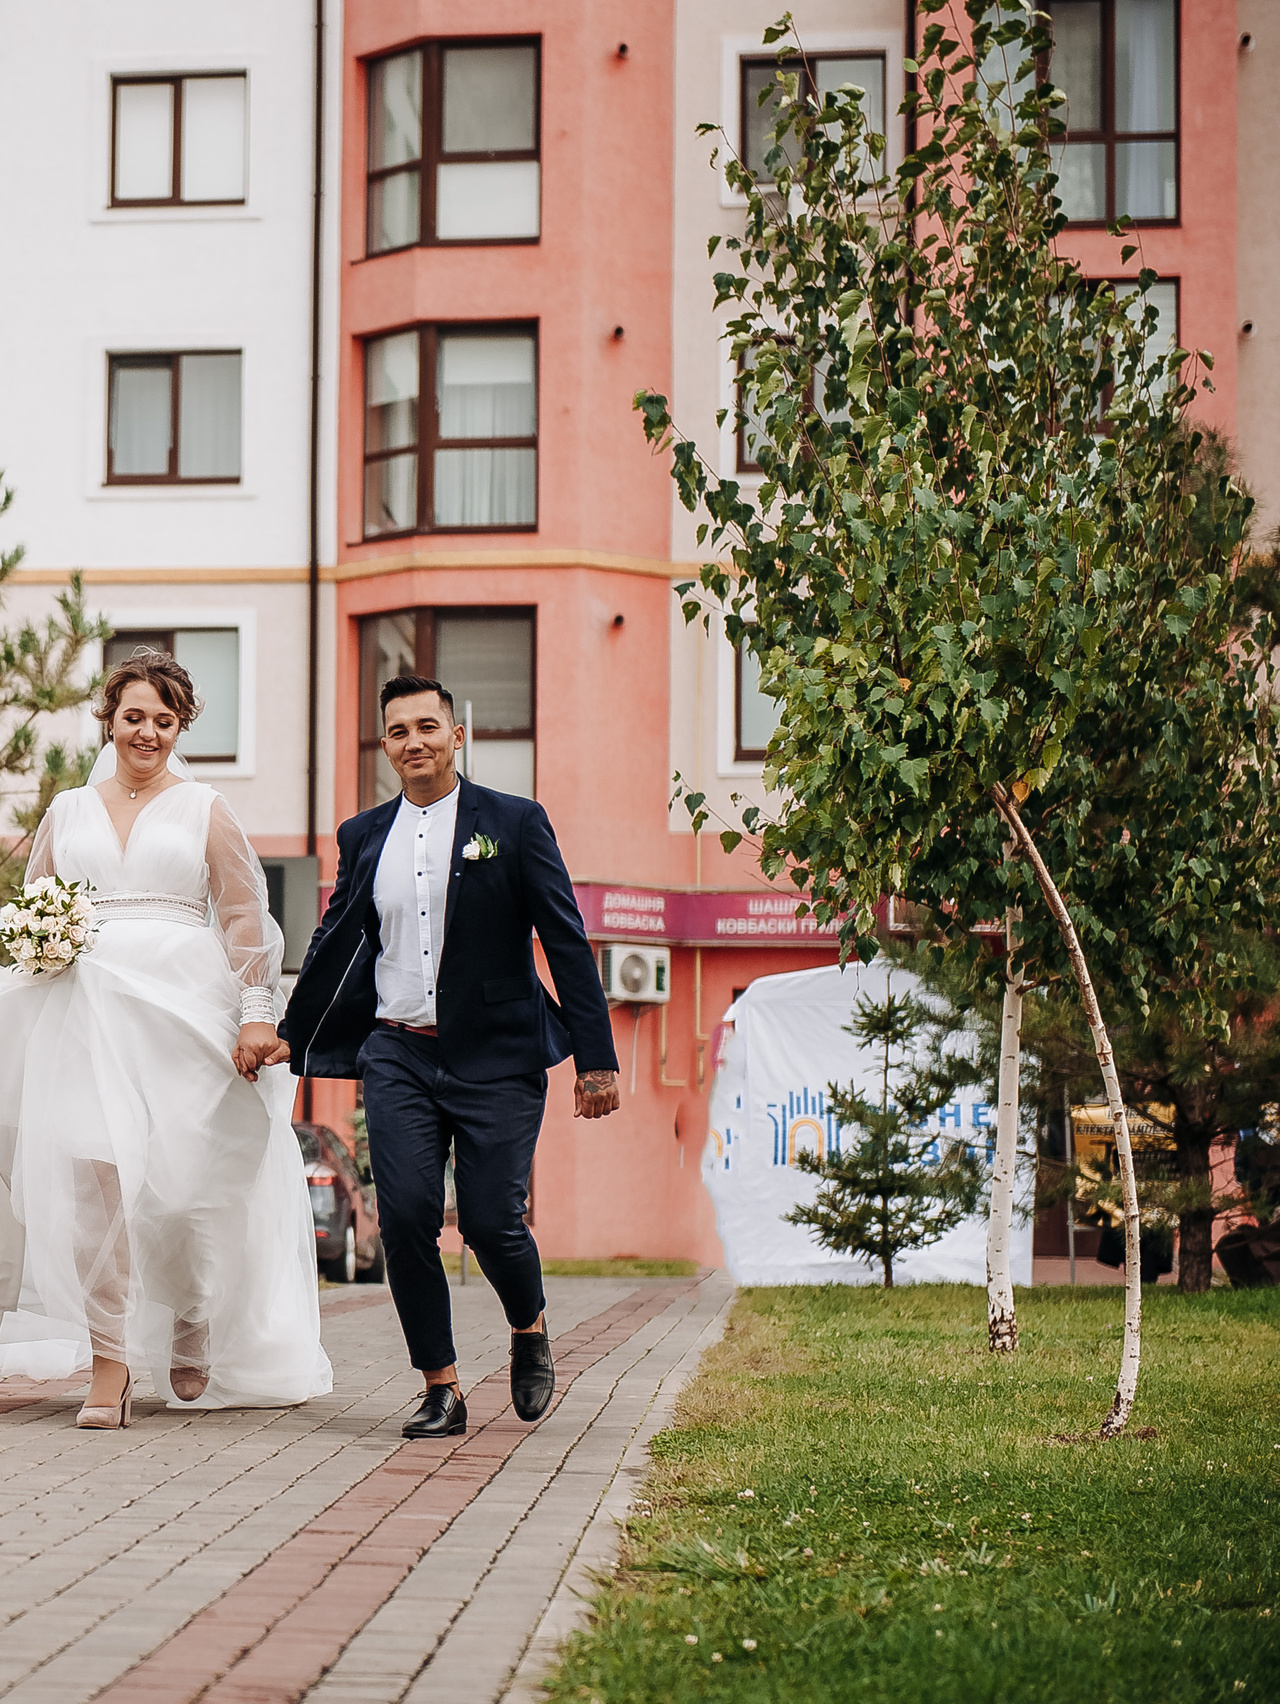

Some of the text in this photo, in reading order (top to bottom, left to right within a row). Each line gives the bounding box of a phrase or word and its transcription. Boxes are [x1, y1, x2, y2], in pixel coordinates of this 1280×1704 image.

[604, 892, 665, 913] ДОМАШНЯ
[603, 912, 666, 932] КОВБАСКА
[716, 918, 797, 934] КОВБАСКИ
